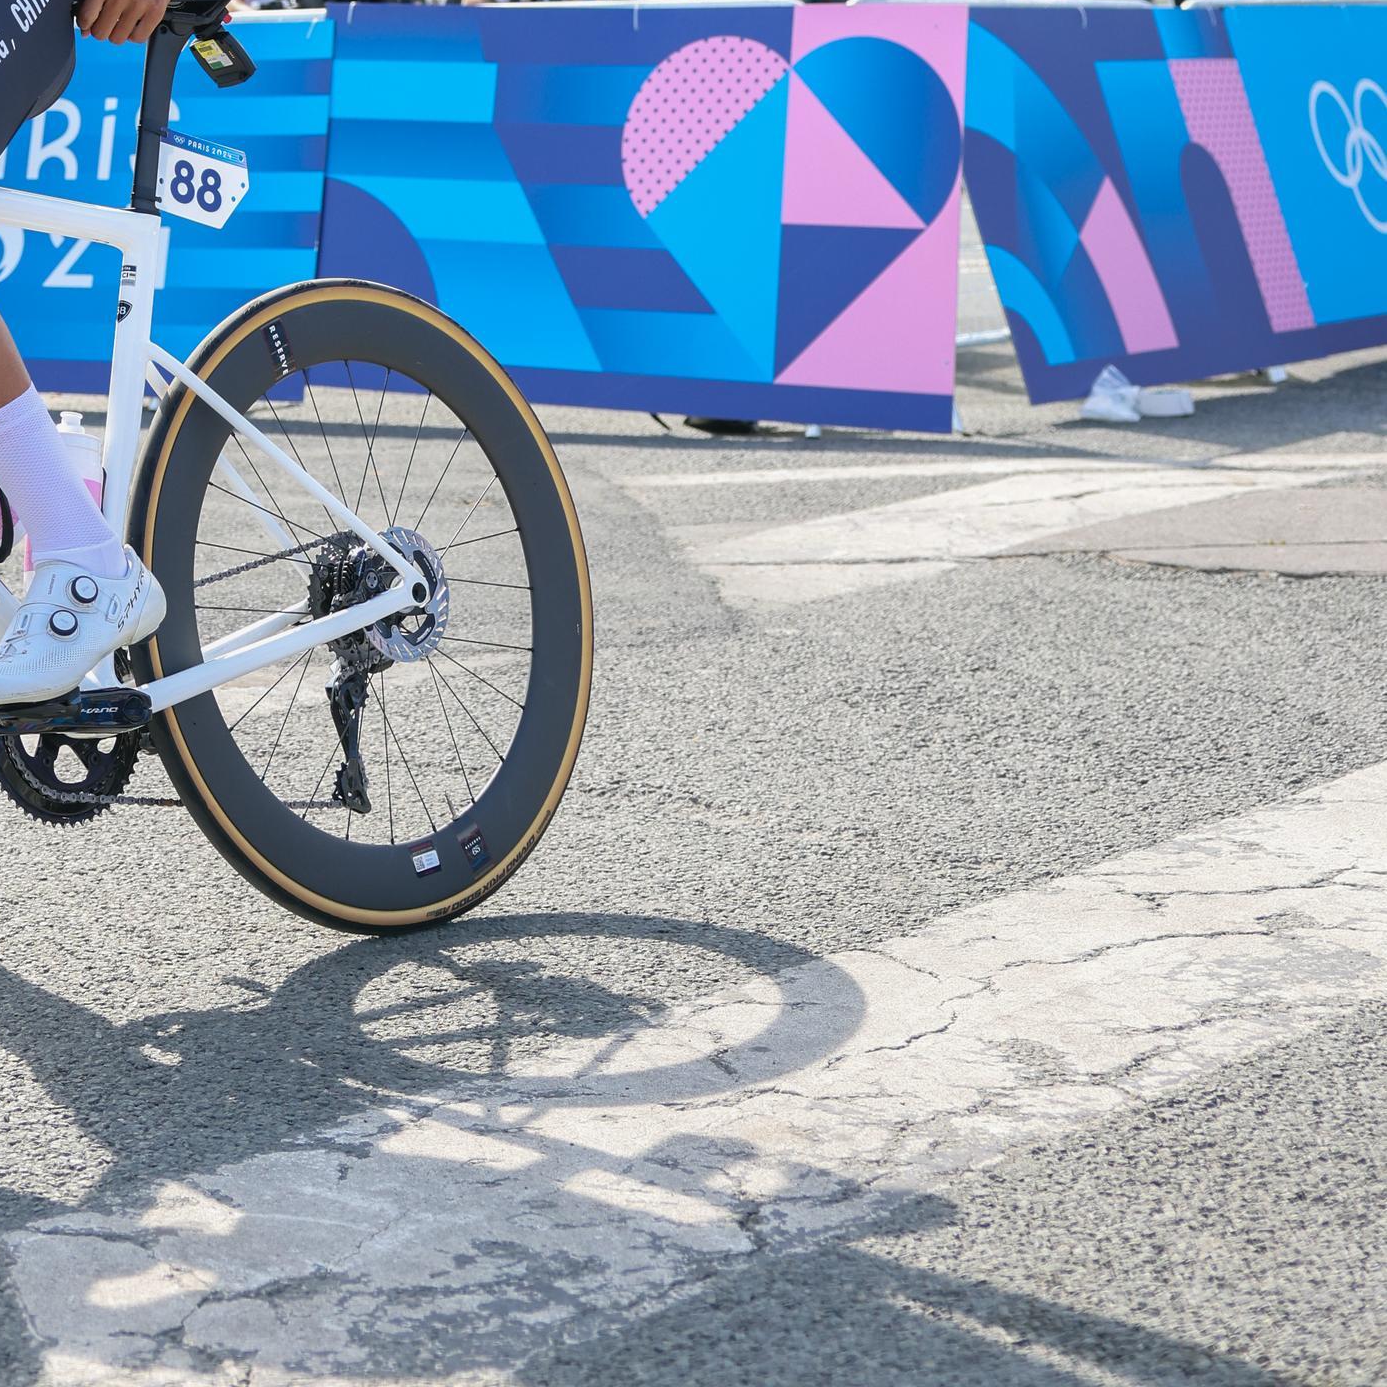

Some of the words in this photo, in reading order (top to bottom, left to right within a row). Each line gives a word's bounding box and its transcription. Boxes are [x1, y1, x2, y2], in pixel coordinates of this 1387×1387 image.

[187, 139, 210, 153] PARIS
[170, 159, 222, 213] 88
[269, 325, 289, 376] RESERVE
[506, 834, 535, 872] GRAND
[481, 868, 507, 892] PRIX
[452, 888, 482, 910] 5000
